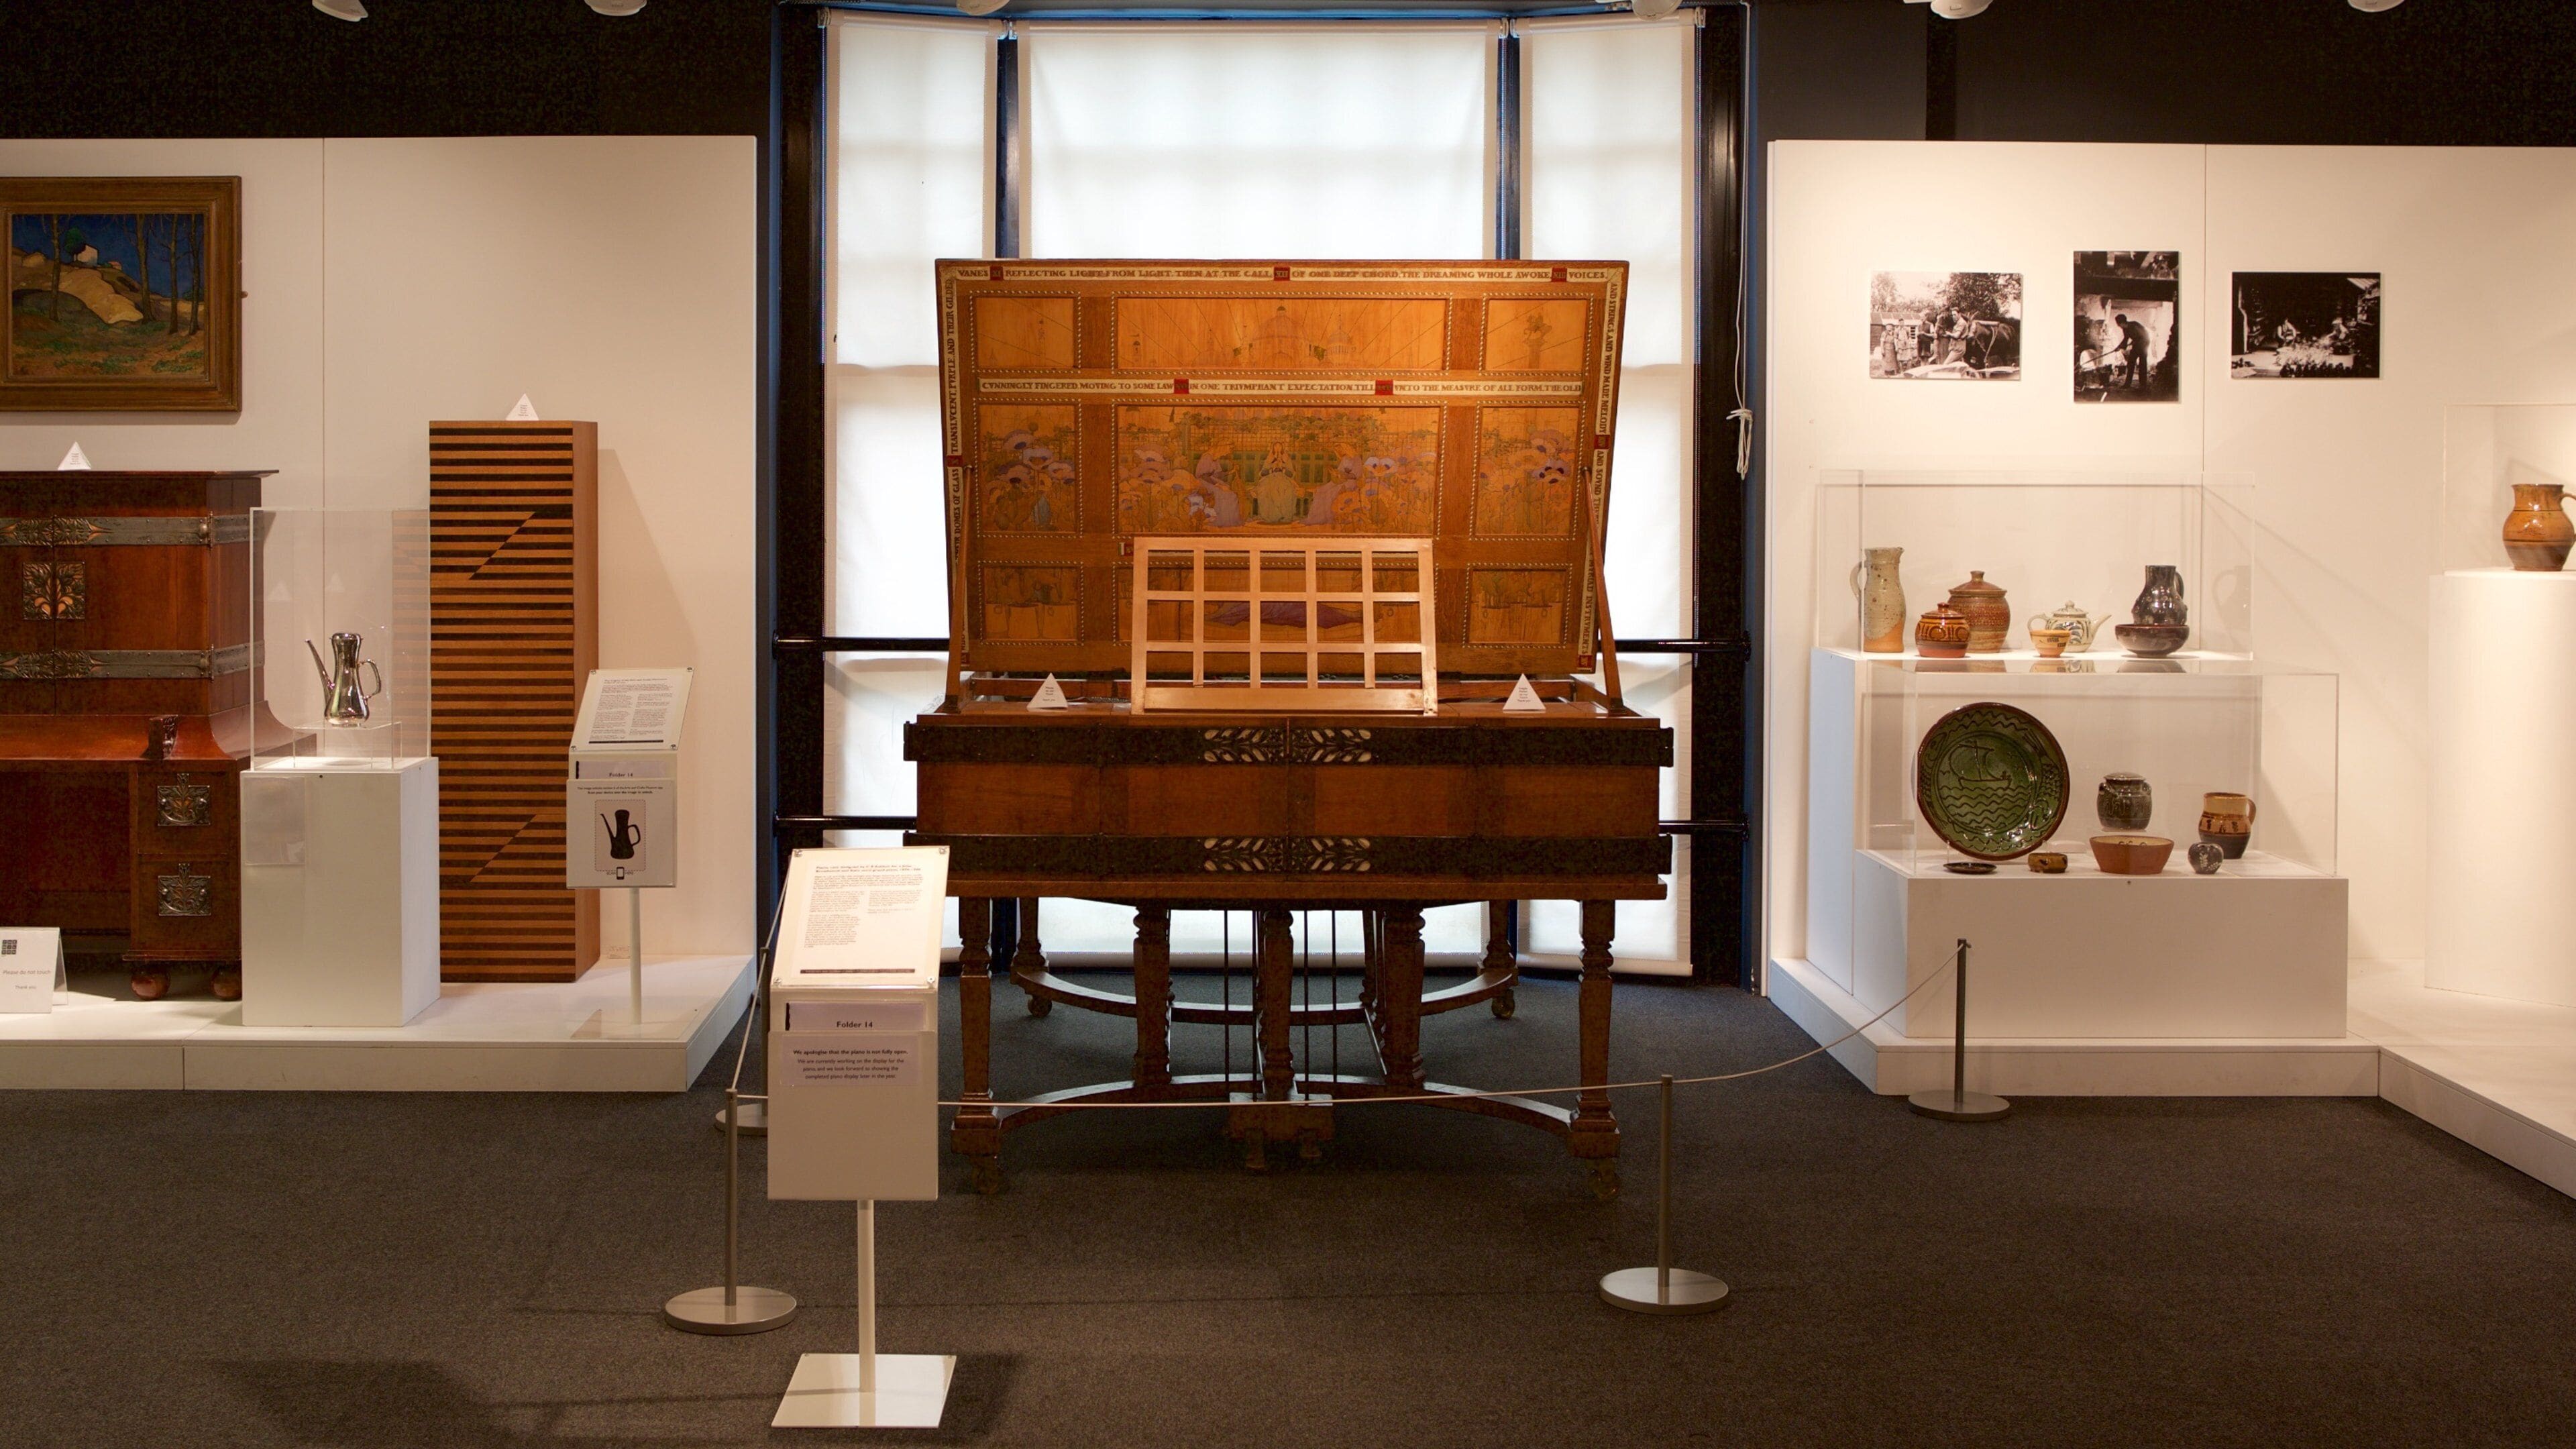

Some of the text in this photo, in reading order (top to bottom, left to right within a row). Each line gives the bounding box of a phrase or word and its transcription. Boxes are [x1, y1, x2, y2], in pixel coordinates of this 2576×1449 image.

[946, 311, 954, 335] THEIR
[947, 338, 955, 355] AND
[1602, 376, 1610, 398] MADE
[1599, 400, 1608, 433] MELODY
[1597, 451, 1605, 466] AND
[953, 495, 960, 504] OF
